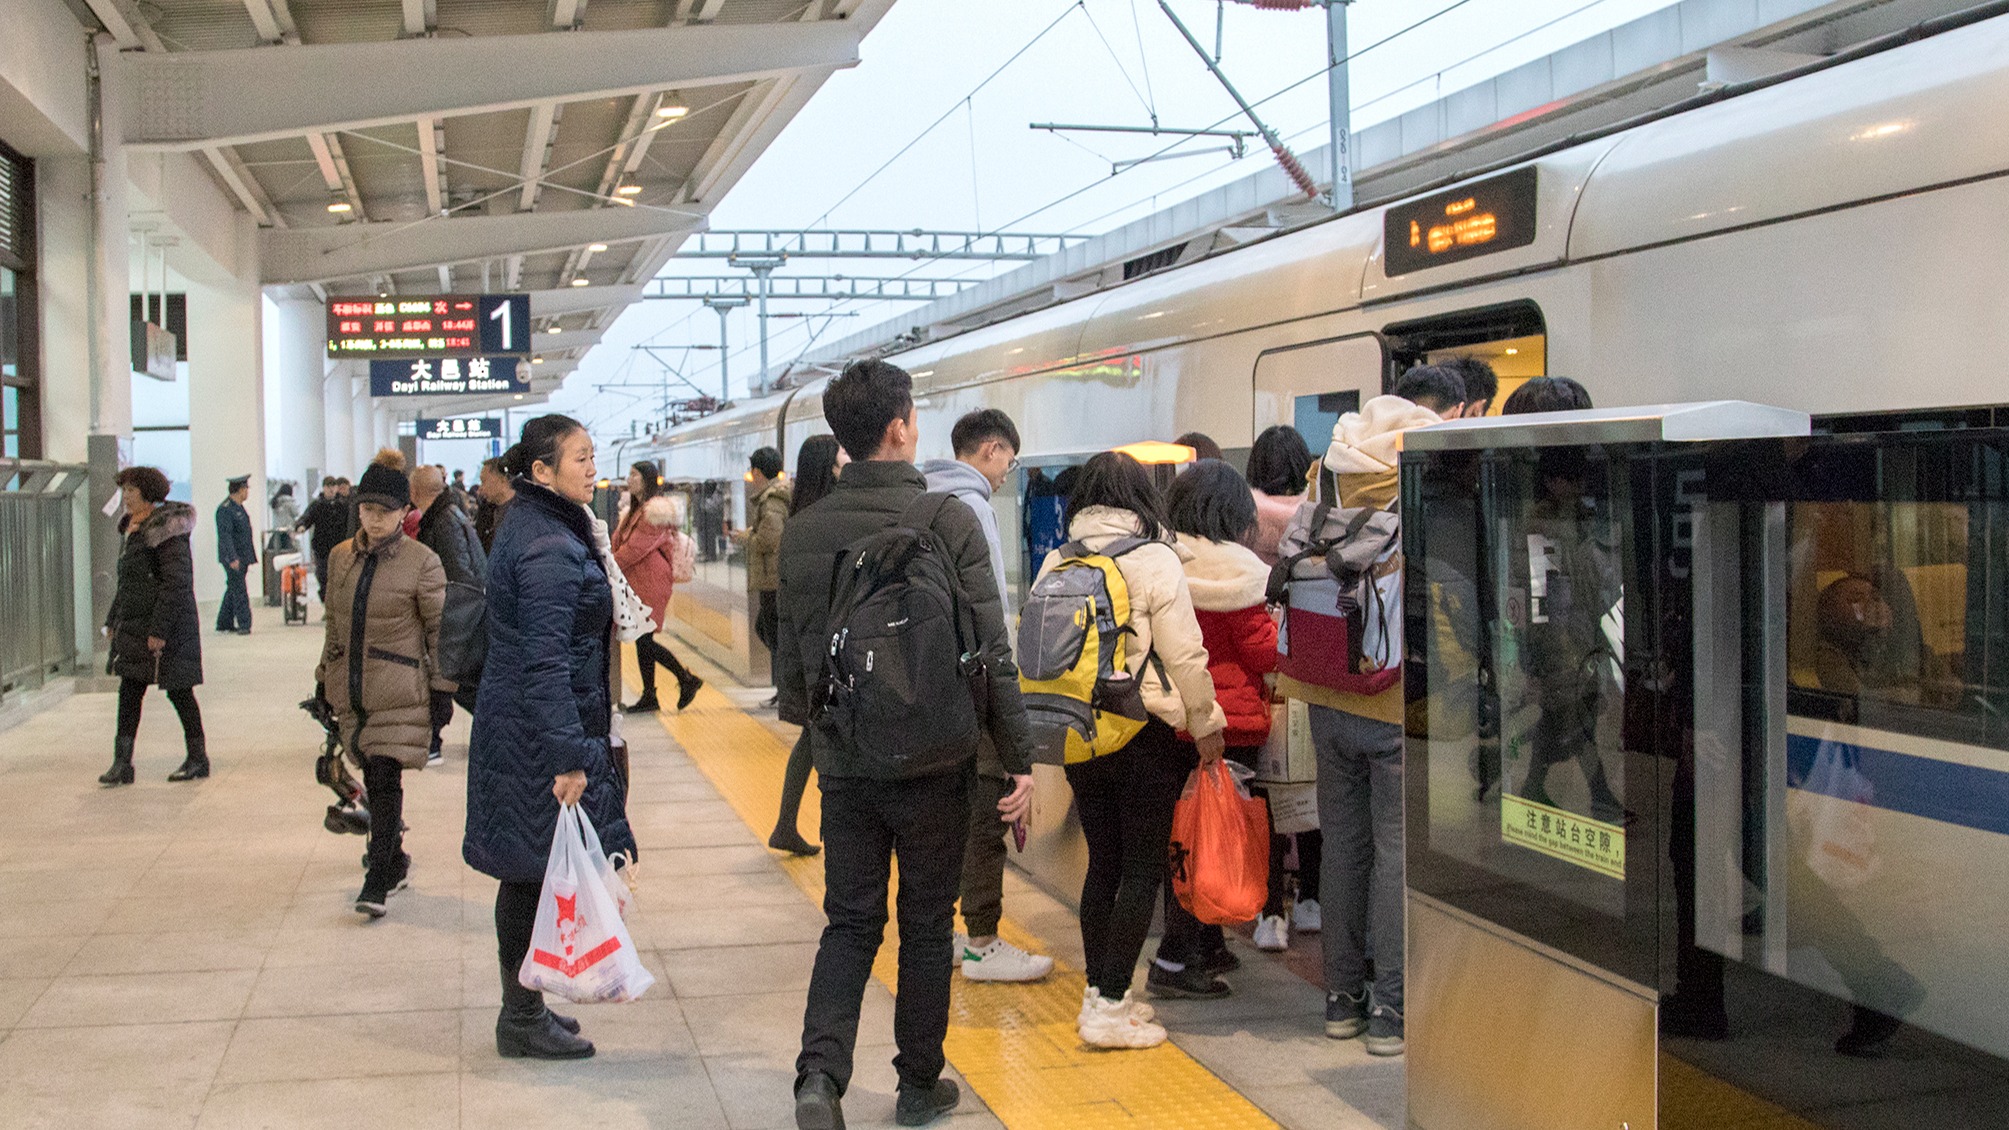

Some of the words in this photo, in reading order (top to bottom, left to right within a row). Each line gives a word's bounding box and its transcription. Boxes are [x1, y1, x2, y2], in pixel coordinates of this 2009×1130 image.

[489, 299, 512, 350] 1
[410, 358, 490, 380] 大邑站
[391, 380, 418, 394] Dayi
[421, 380, 466, 393] Railway
[468, 378, 509, 391] Station
[1506, 823, 1523, 836] Please
[1524, 829, 1538, 840] mind
[1538, 832, 1547, 844] the
[1548, 837, 1558, 850] gap
[1559, 841, 1583, 856] between
[1584, 848, 1594, 859] the
[1595, 852, 1609, 865] train
